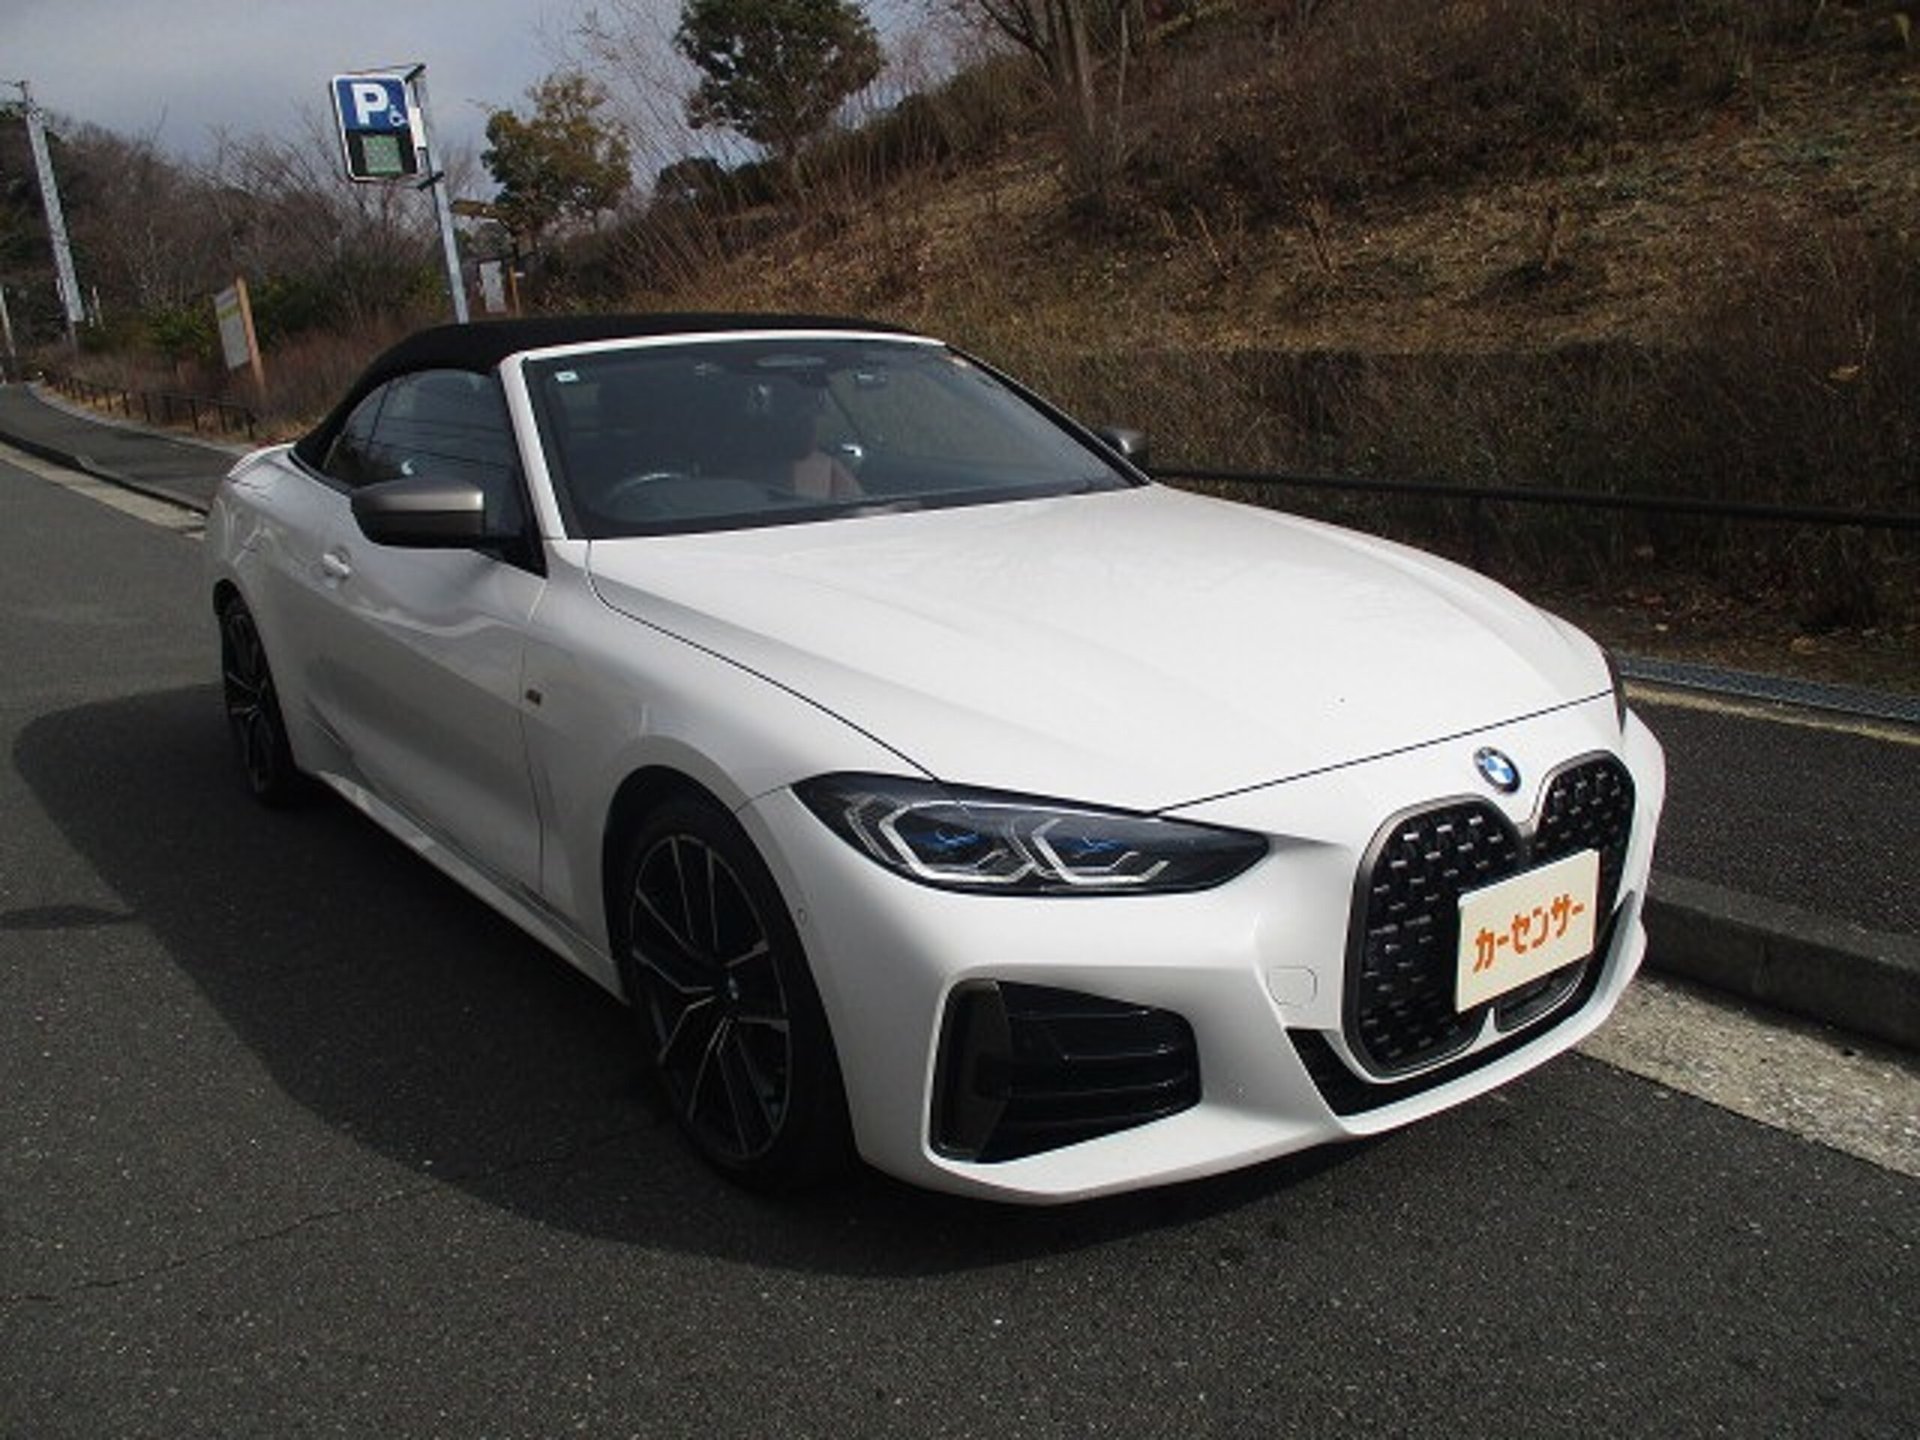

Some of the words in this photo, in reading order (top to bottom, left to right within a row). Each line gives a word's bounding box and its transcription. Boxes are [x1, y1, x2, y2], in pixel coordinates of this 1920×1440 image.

[351, 83, 388, 125] P
[1473, 894, 1584, 973] カーセンサー
